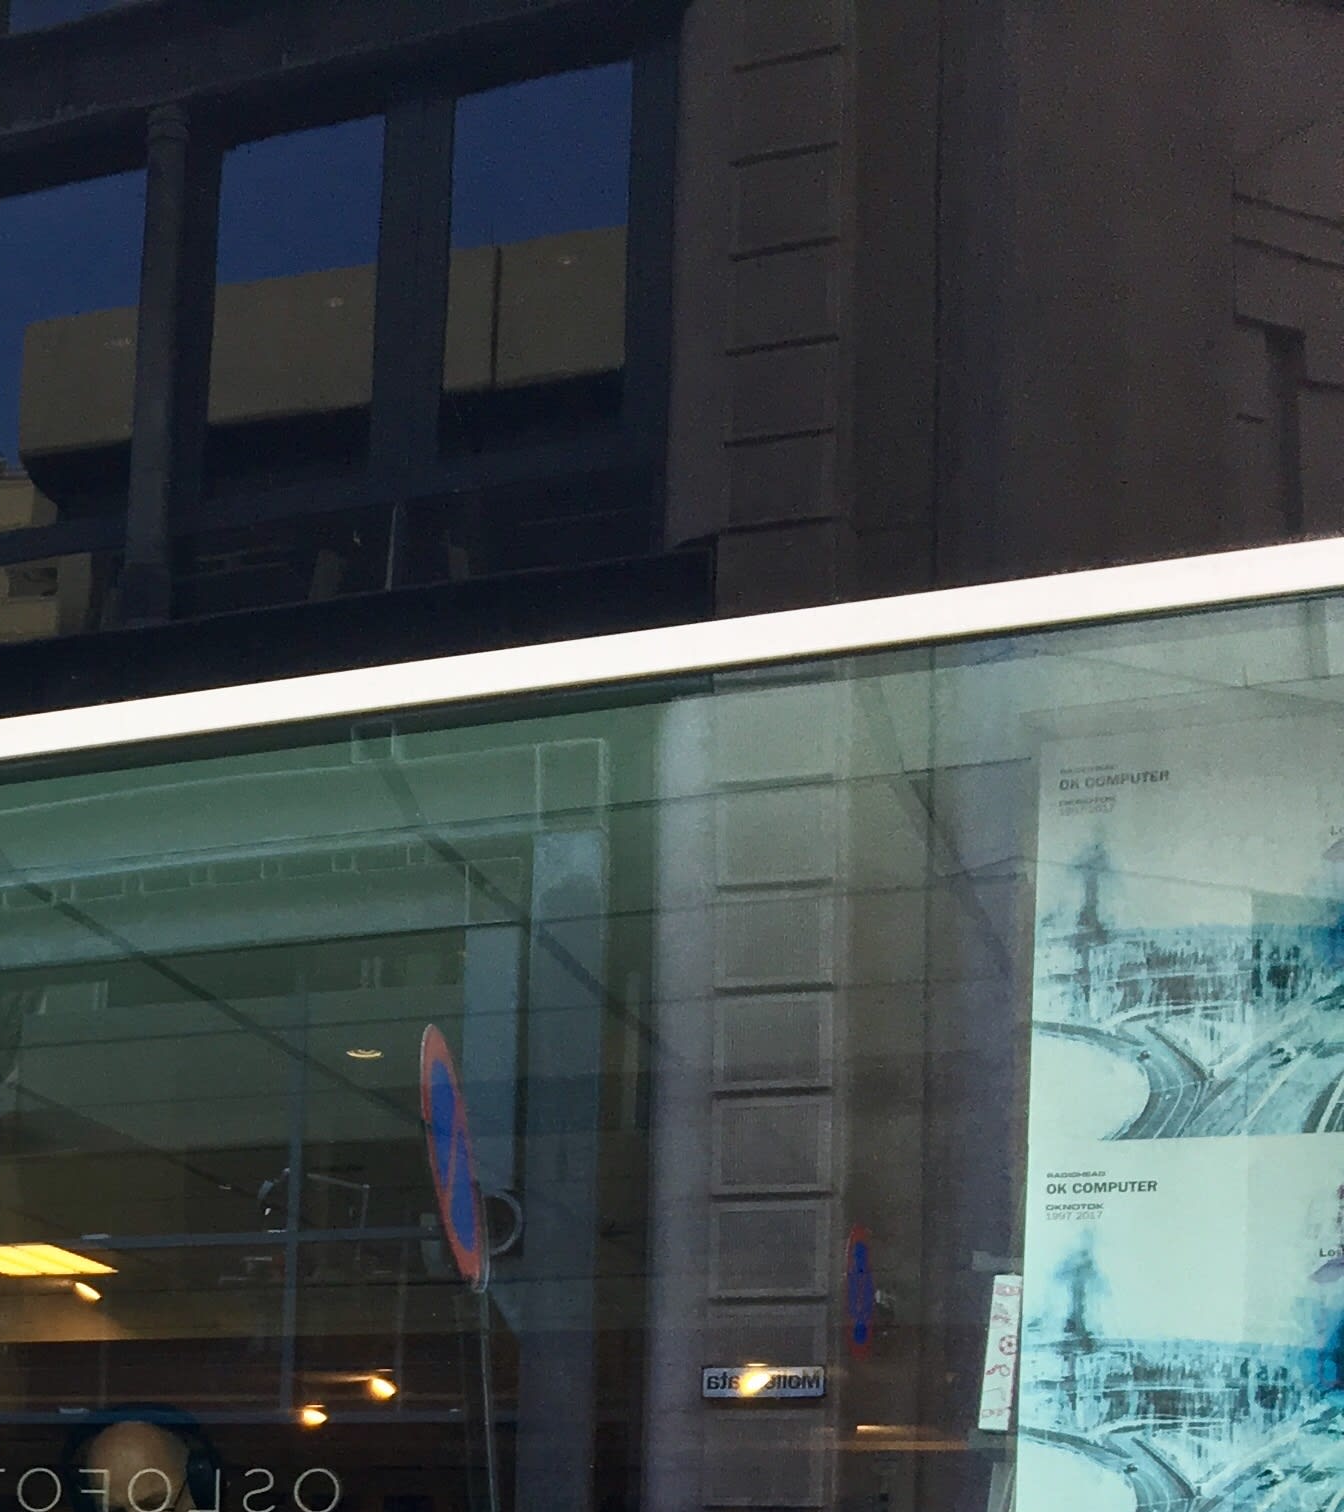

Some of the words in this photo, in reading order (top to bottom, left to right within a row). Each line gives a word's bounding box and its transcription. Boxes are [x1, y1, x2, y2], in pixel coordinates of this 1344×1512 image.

[1084, 769, 1170, 789] COMPUTER
[1047, 1171, 1106, 1179] RADIOHEAD
[1046, 1182, 1067, 1195] OK
[1072, 1180, 1158, 1195] COMPUTER
[1045, 1203, 1105, 1212] OKNOTOK
[1045, 1211, 1073, 1221] 1997
[1075, 1210, 1104, 1221] 2017
